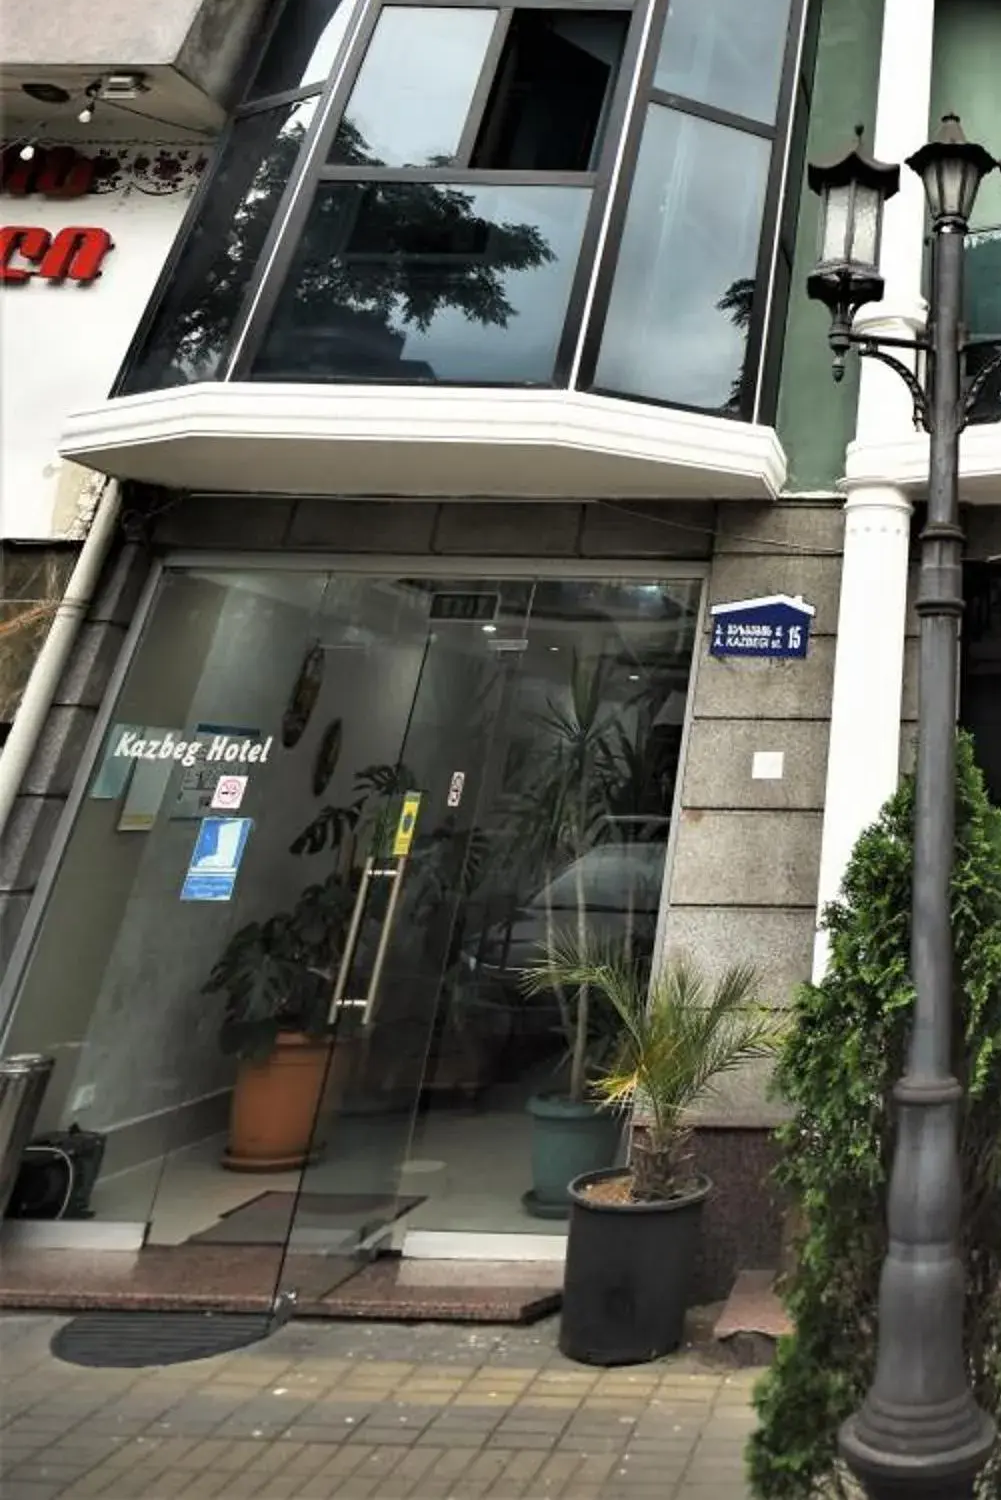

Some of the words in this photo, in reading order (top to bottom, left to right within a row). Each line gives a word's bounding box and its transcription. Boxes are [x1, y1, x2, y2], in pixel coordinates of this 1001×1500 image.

[788, 625, 802, 648] 15
[113, 732, 202, 767] Kazbeg
[206, 736, 274, 764] Hotel
